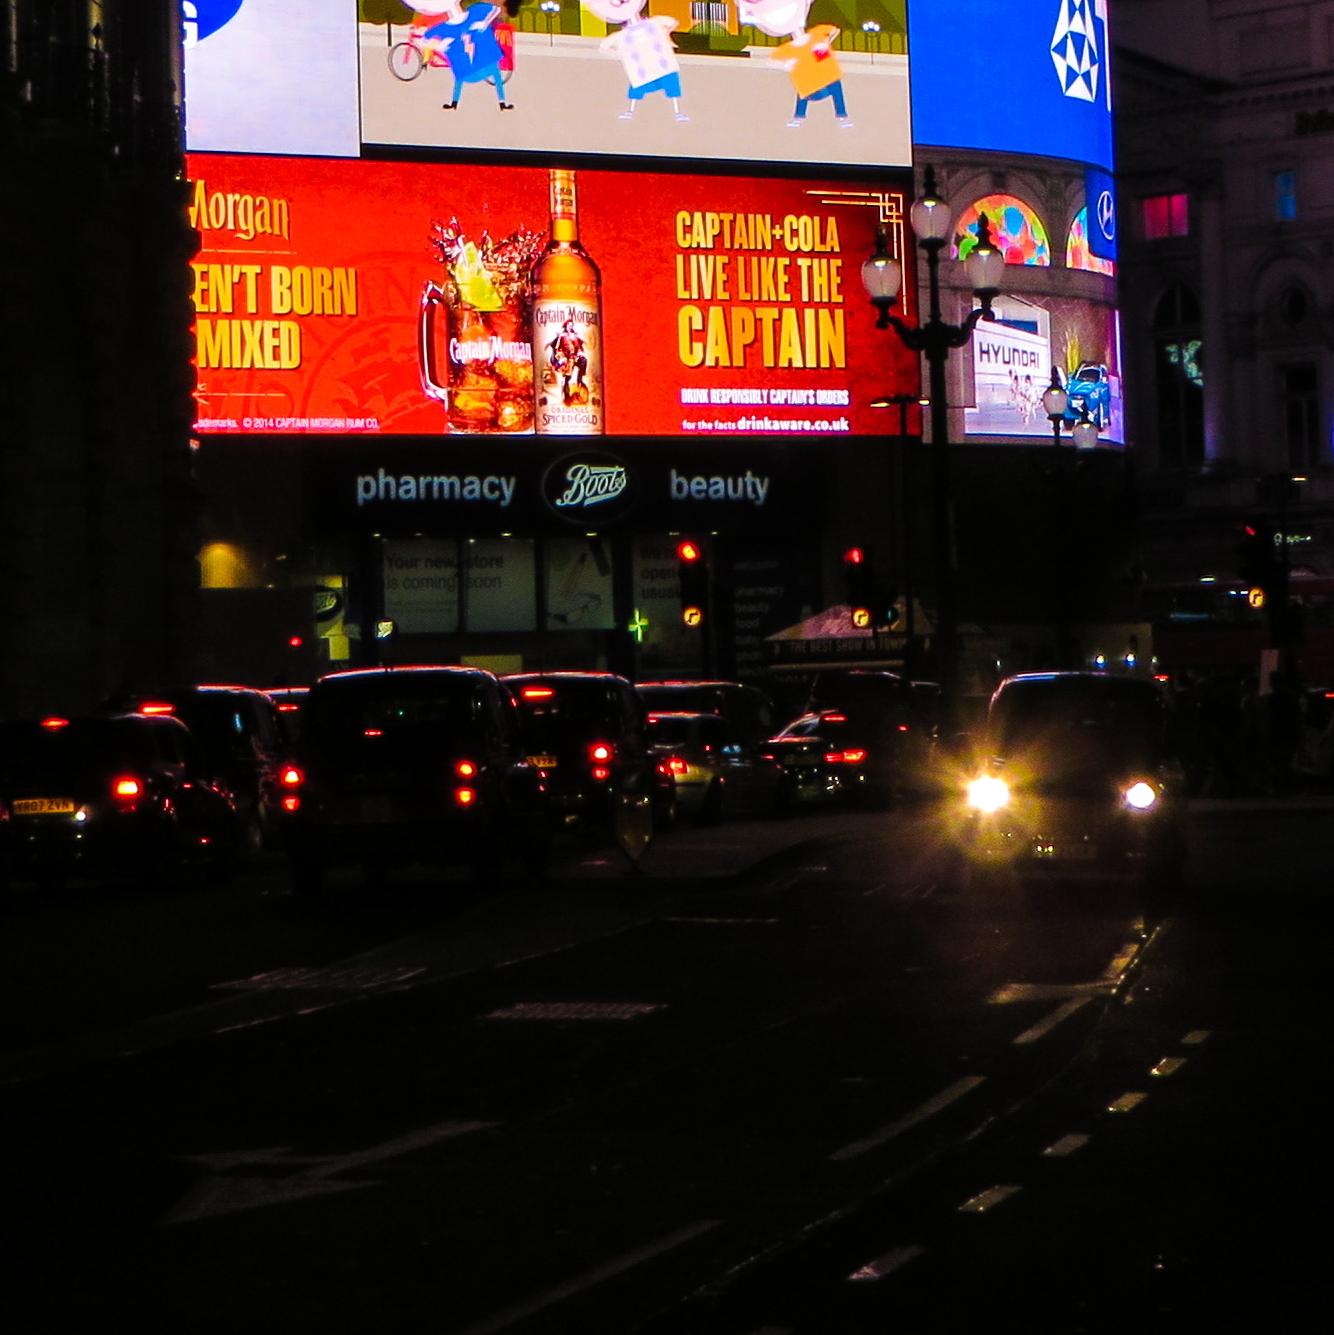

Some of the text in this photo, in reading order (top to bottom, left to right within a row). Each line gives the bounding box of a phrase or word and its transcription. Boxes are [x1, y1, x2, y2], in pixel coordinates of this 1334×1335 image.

[188, 179, 289, 241] Morgan
[271, 266, 358, 316] BORN
[676, 254, 844, 303] LIVE LIKE THE
[197, 319, 302, 370] MIXED
[677, 304, 846, 368] CAPTAIN
[979, 341, 1040, 369] HYUNDAI
[681, 388, 708, 404] DRINK
[710, 388, 768, 404] RESPONSIBLY
[817, 389, 849, 405] ORDERS
[682, 416, 849, 431] for the facts drinkaware.co.uk
[356, 467, 517, 508] pharmacy
[555, 464, 627, 507] Boots
[670, 468, 770, 506] beauty
